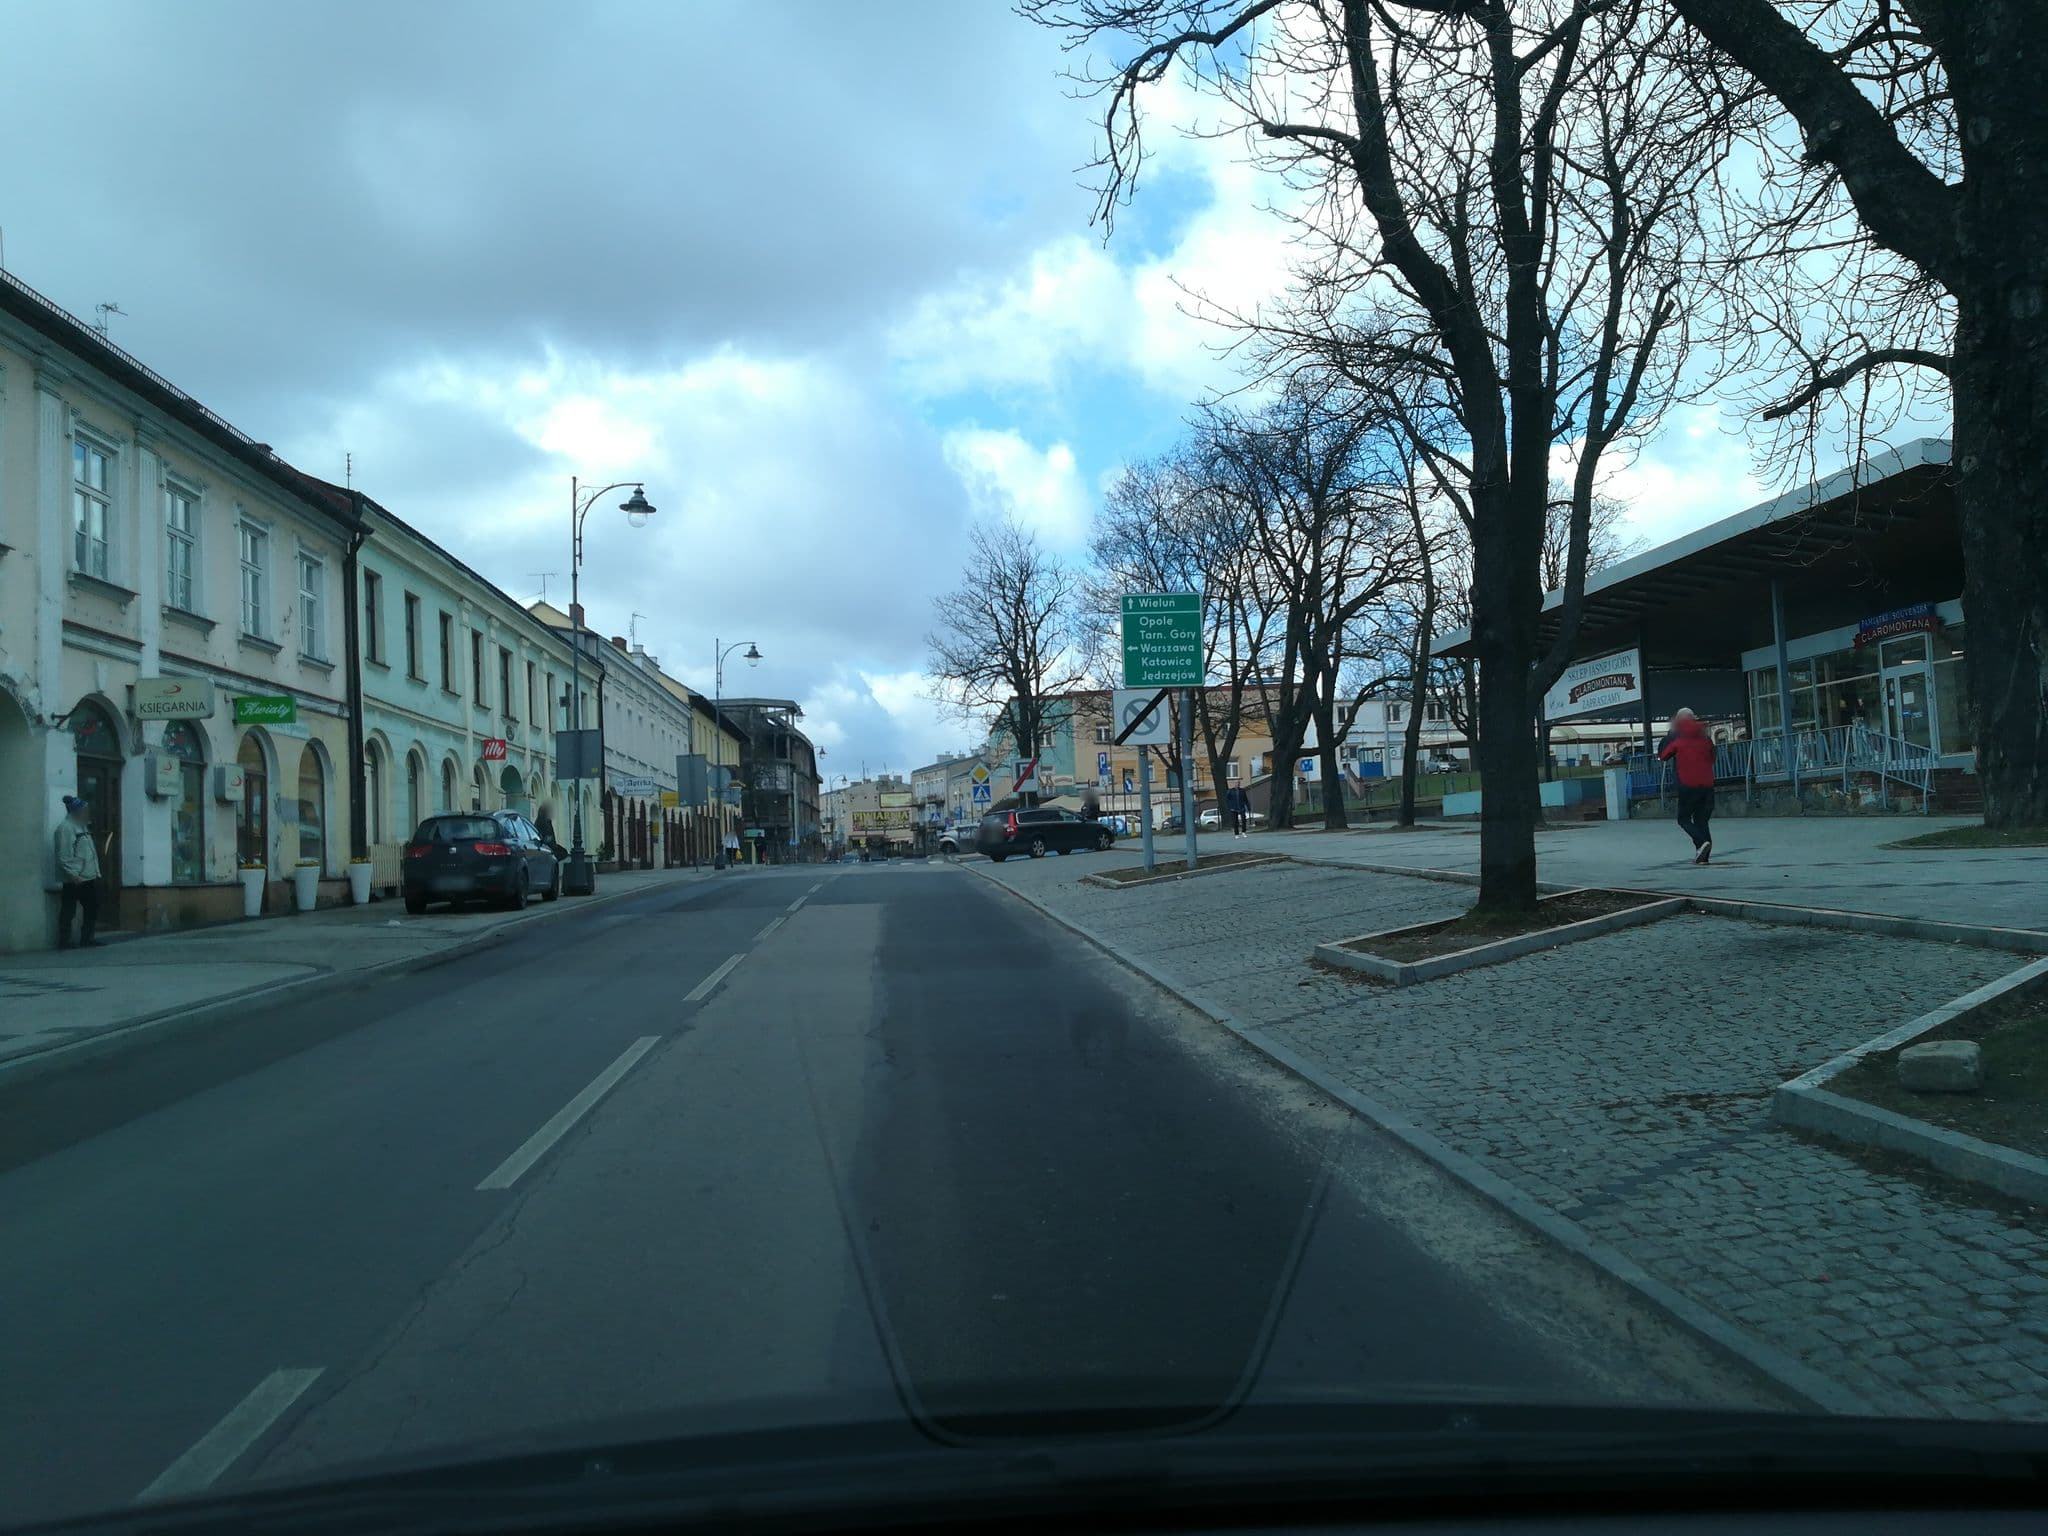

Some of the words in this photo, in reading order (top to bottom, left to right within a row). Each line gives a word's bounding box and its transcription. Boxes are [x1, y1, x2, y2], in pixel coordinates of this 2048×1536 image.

[1139, 598, 1175, 608] Wieluń
[1140, 616, 1173, 628] Opole
[1139, 630, 1166, 640] Tarn.
[1170, 629, 1196, 640] Góry
[1861, 619, 1930, 642] CLAROMONTANA
[1140, 643, 1195, 653] Warszawa
[1141, 657, 1192, 667] Katowice
[1142, 670, 1196, 682] Jędrzejów
[1568, 668, 1587, 682] SKLEP
[1574, 676, 1628, 698] CLAROMONTANA
[139, 701, 207, 715] KSIĘGARNIA
[240, 701, 291, 718] Kwiaty
